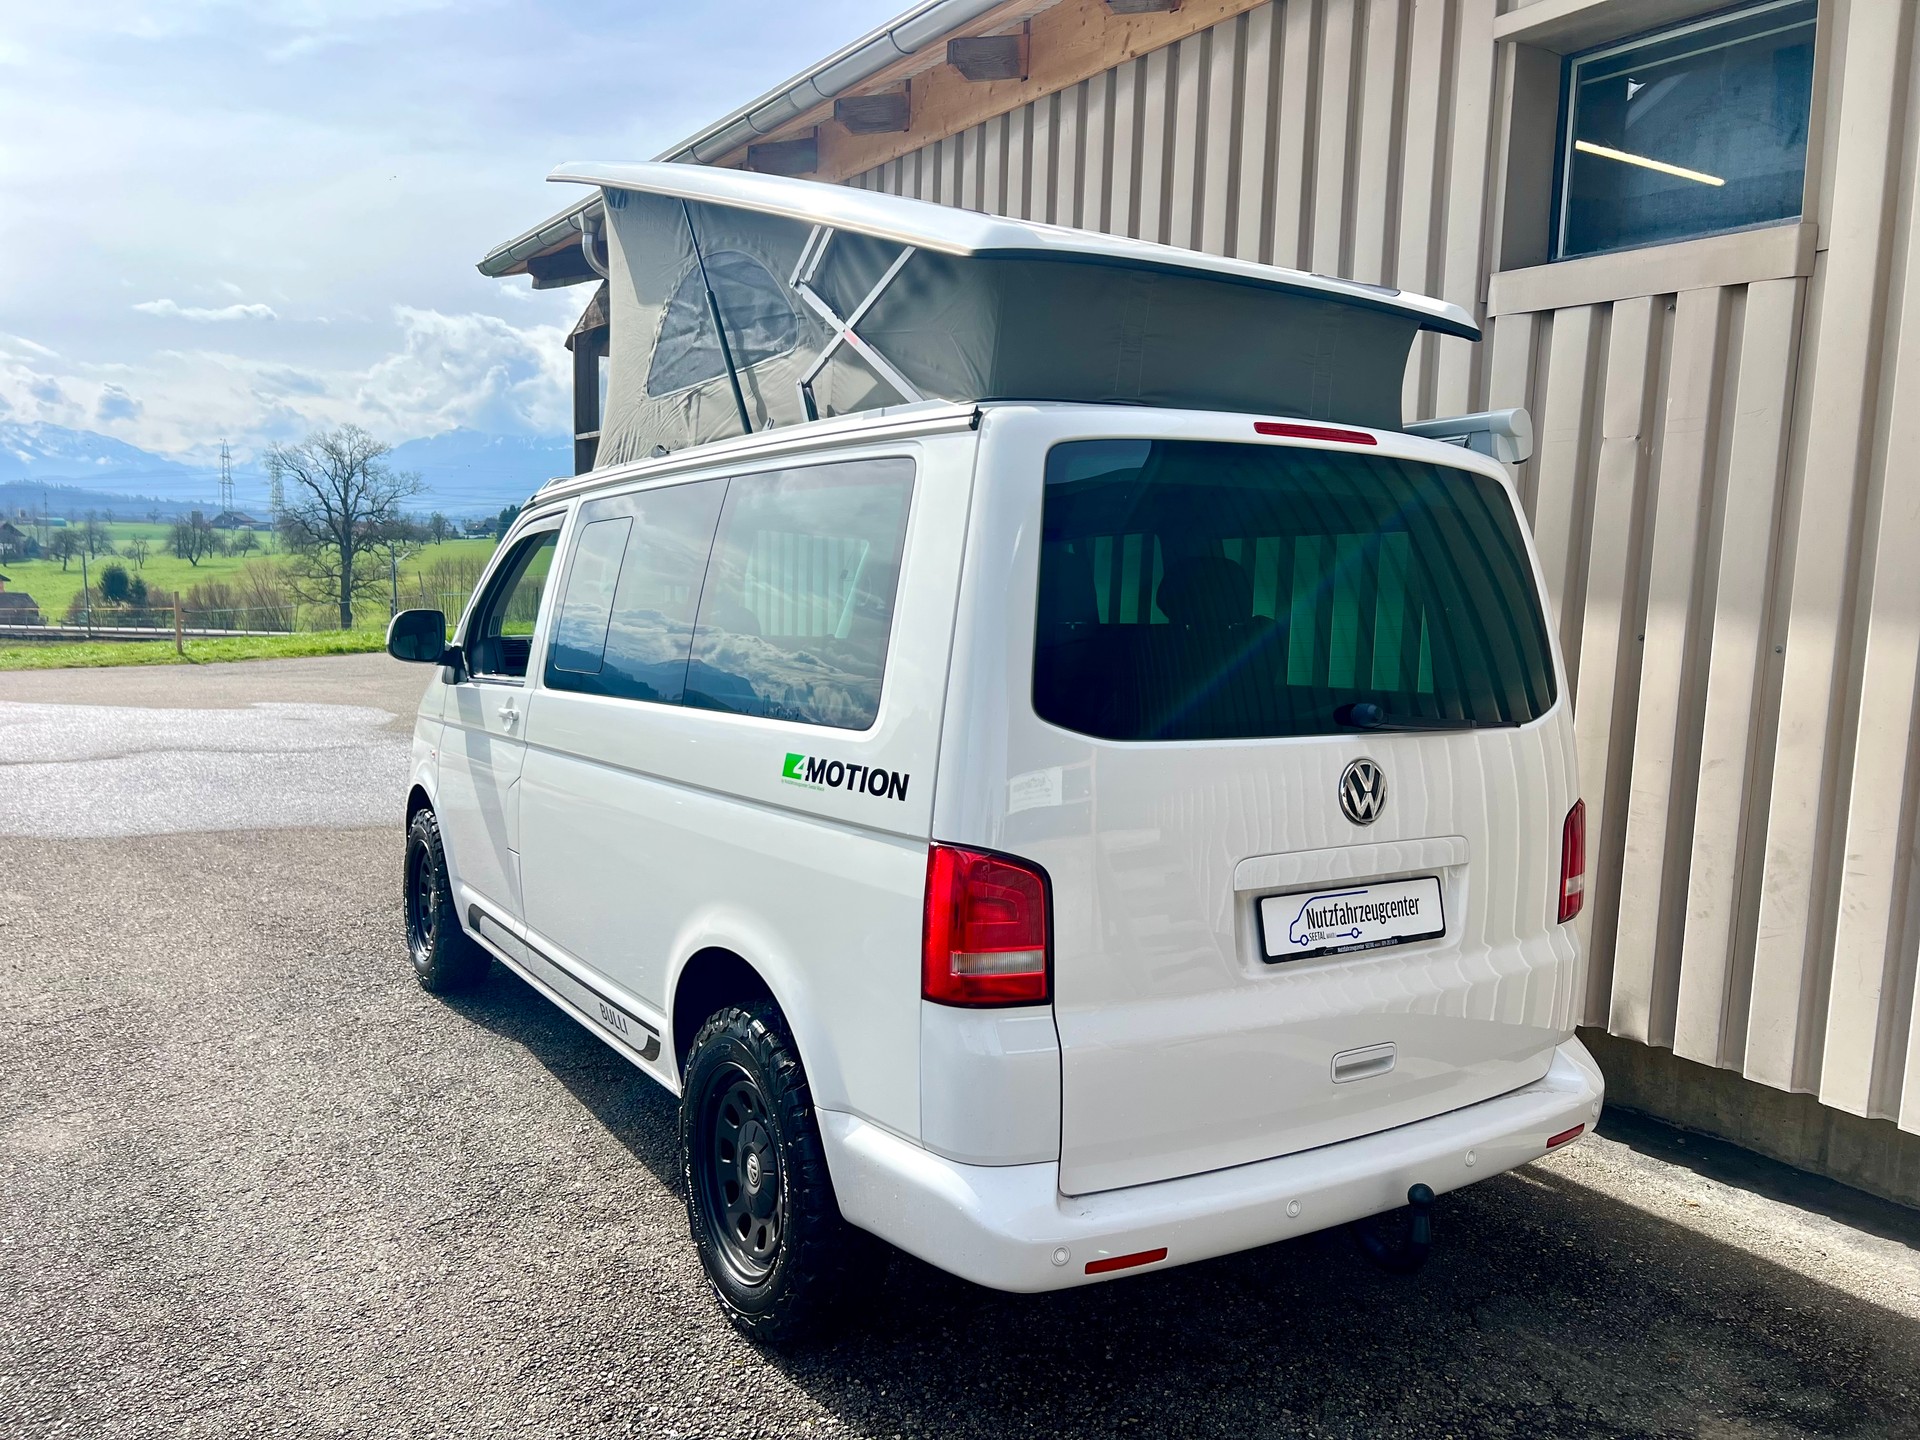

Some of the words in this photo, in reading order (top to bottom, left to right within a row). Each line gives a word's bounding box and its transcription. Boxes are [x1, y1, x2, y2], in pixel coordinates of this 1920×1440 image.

[1306, 895, 1420, 930] Nutzfahrzeugcenter
[1308, 931, 1326, 942] SEETAL
[599, 1002, 629, 1036] BULLI
